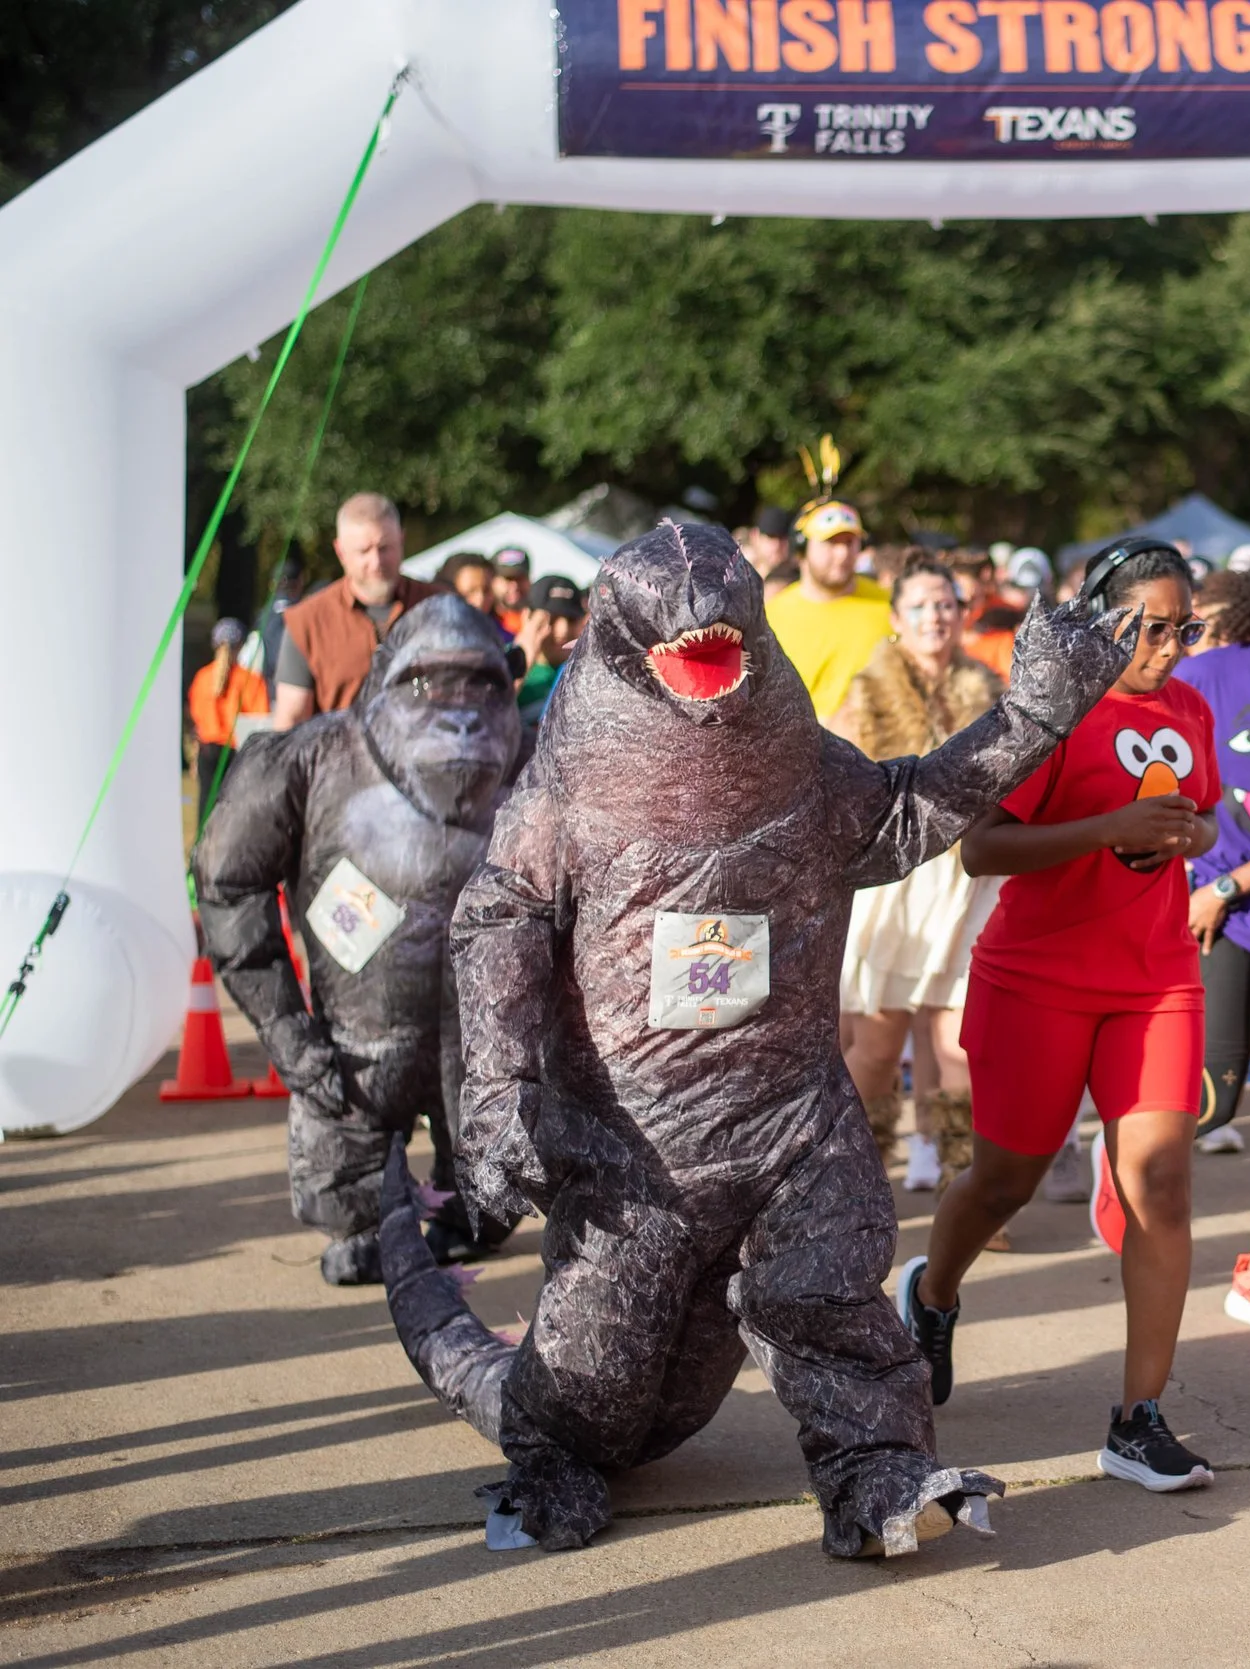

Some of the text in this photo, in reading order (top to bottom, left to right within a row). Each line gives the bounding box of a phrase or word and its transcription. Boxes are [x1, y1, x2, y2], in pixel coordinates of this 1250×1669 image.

[618, 0, 896, 72] FINISH
[813, 104, 934, 130] TRINITY
[984, 106, 1137, 143] TEXANS
[814, 130, 905, 154] FALLS
[688, 962, 731, 994] 54
[713, 997, 749, 1007] TEXANS
